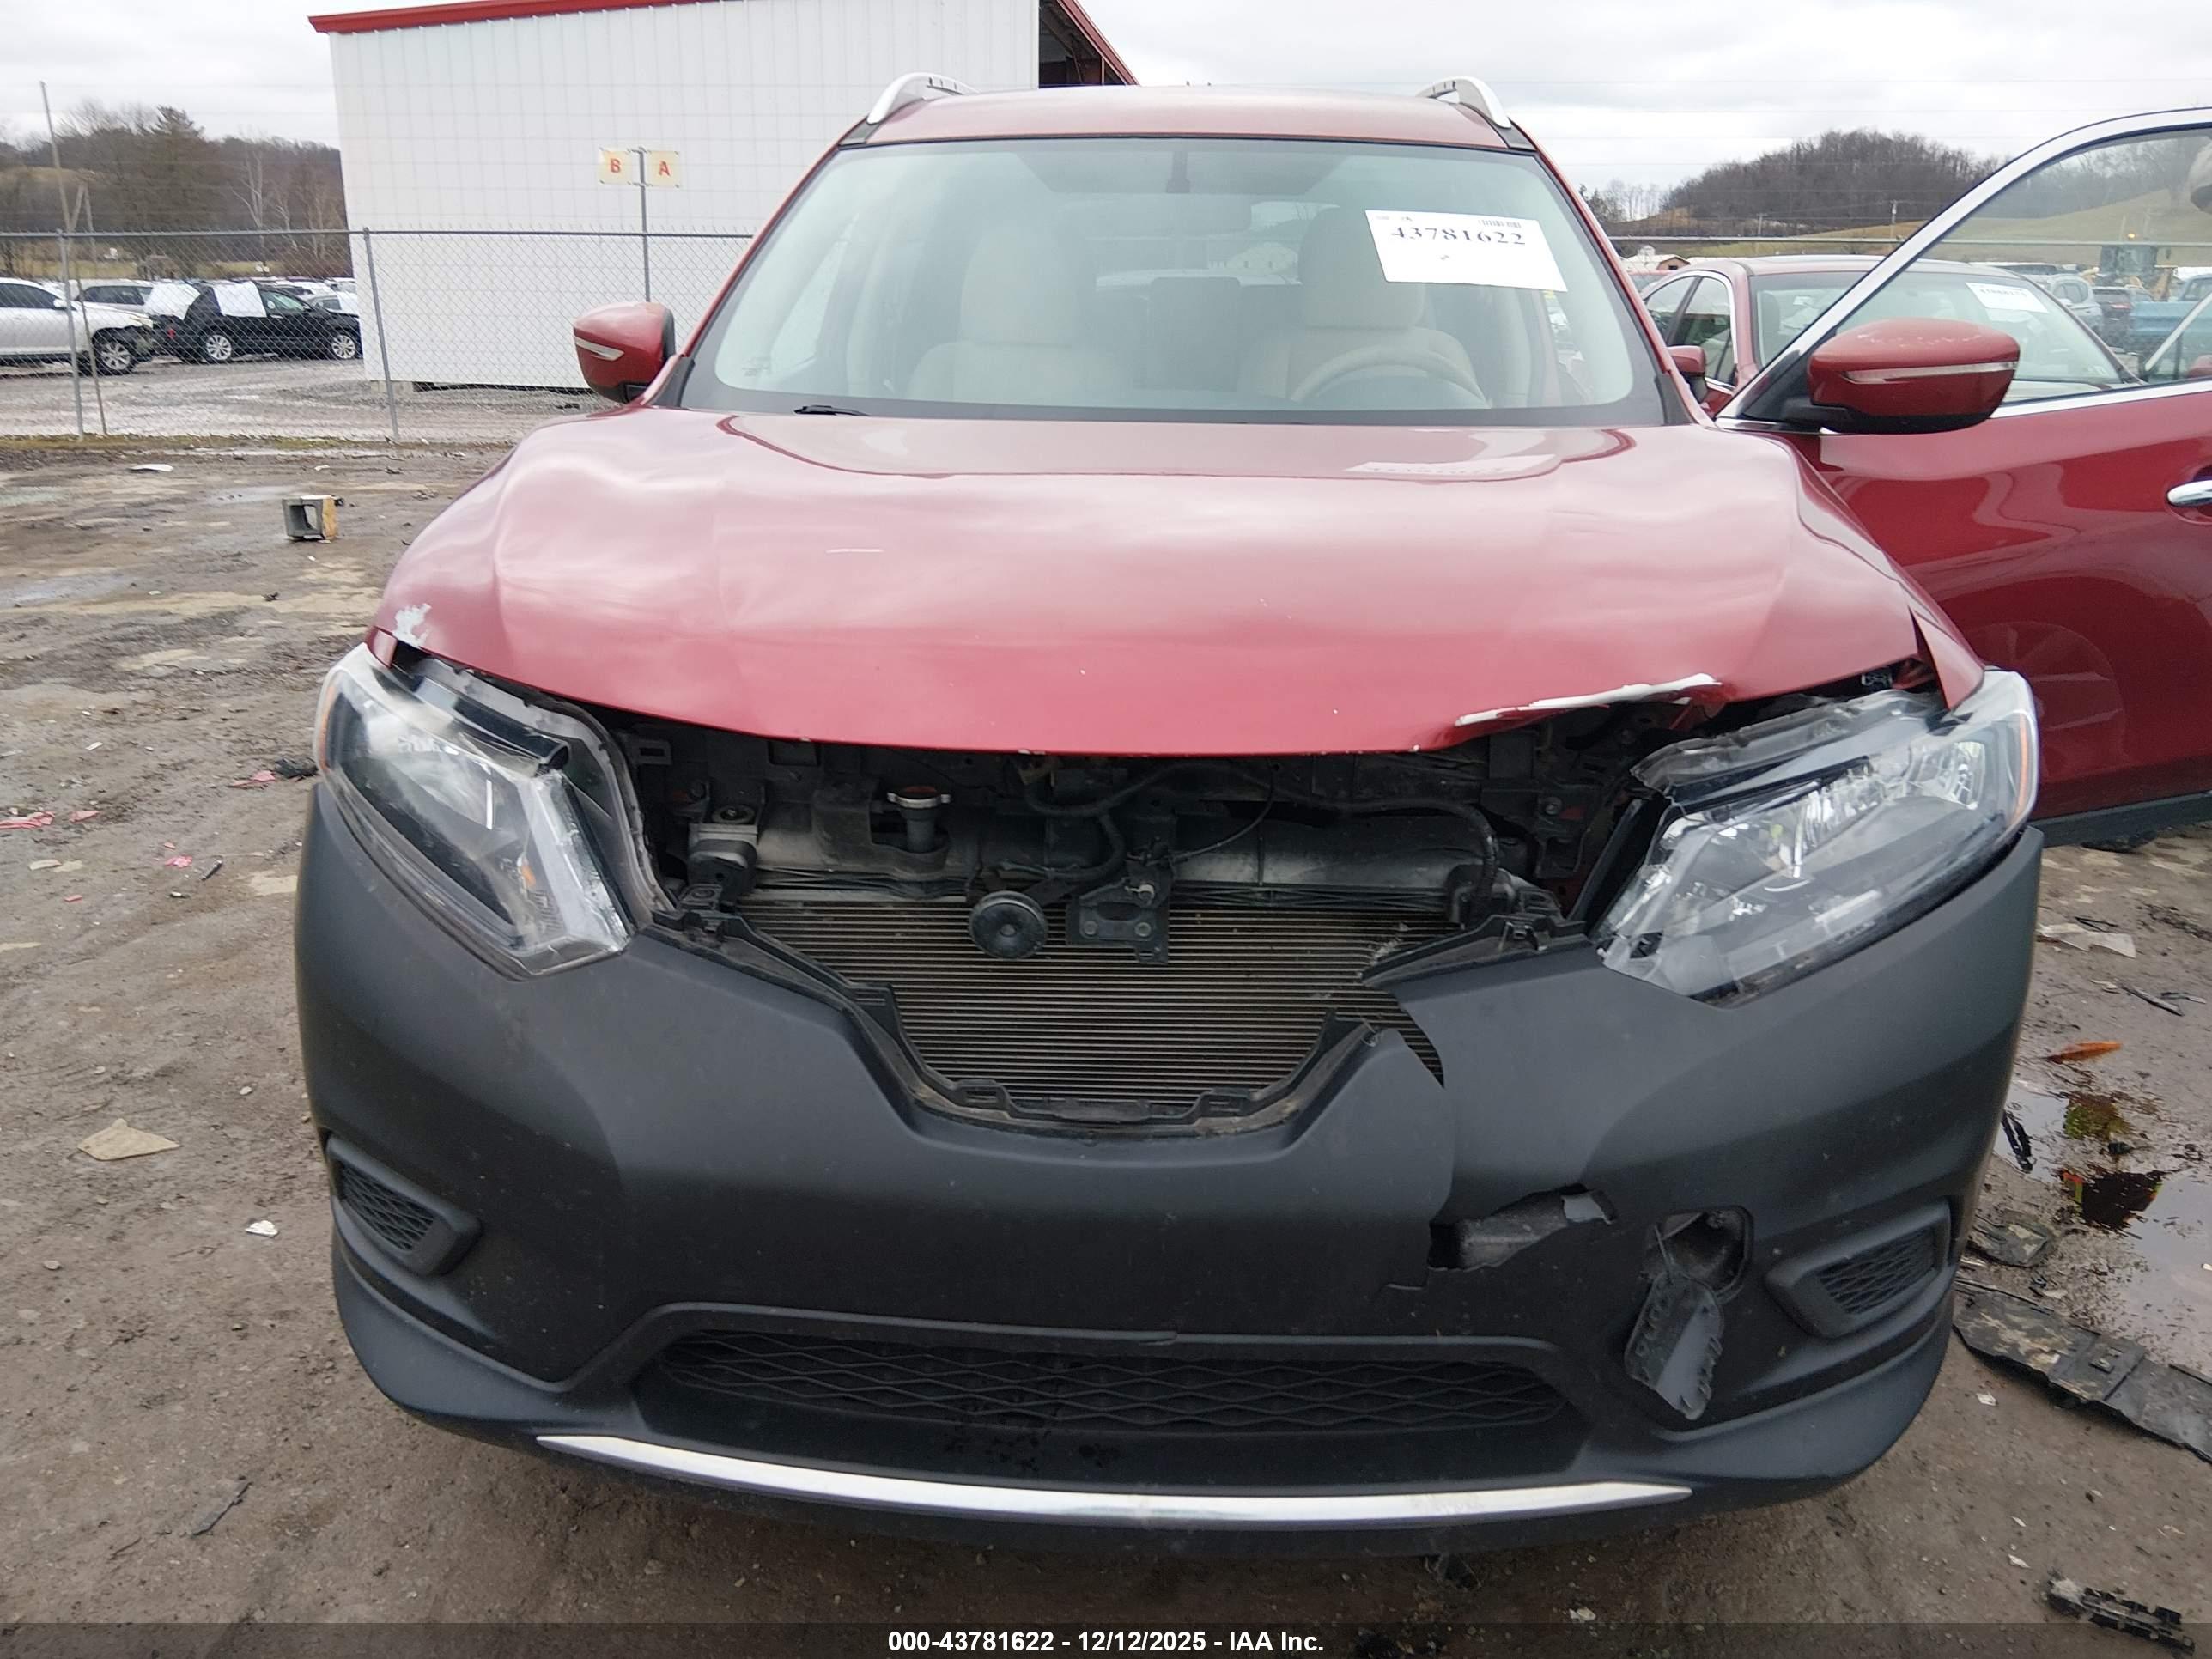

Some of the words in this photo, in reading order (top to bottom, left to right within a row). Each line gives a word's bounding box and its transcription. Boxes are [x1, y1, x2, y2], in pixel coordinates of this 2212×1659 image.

[610, 158, 621, 173] B
[659, 161, 671, 176] A
[1390, 226, 1526, 246] 43781622
